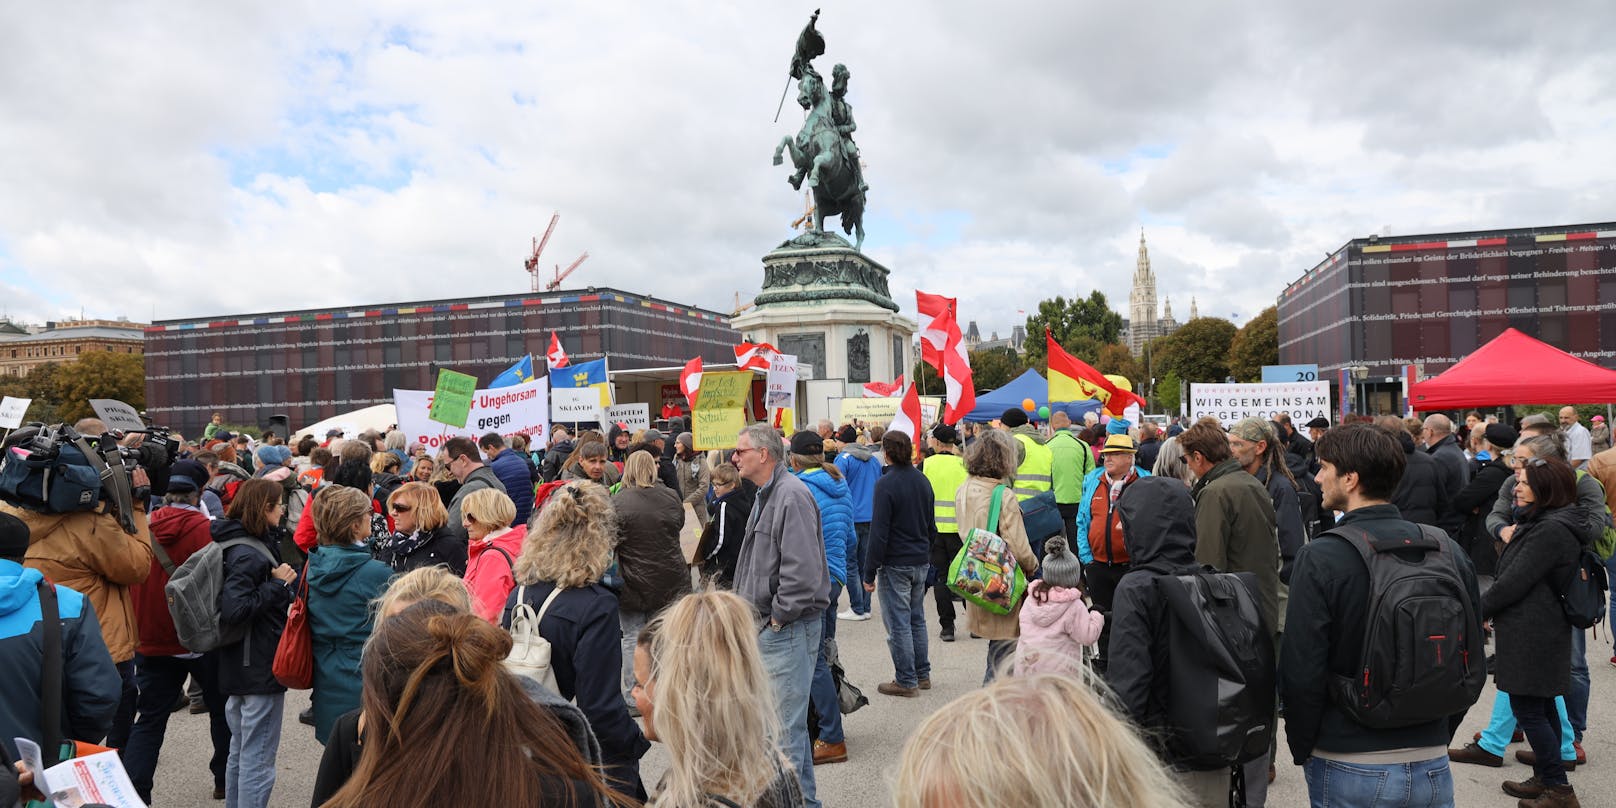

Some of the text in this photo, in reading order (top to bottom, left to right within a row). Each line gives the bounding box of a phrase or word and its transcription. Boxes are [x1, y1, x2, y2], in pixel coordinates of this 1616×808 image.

[1460, 251, 1509, 259] Brüderlichkeit
[1510, 248, 1544, 258] begegnen
[1533, 269, 1579, 279] Behinderung
[1362, 313, 1399, 322] Solidarität,
[1436, 309, 1482, 319] Gerechtigkeit
[1296, 372, 1315, 382] 20
[480, 389, 536, 409] Ungehorsam
[1196, 397, 1326, 407] WIR GEMEINSAM
[478, 414, 511, 430] gegen
[698, 411, 728, 424] Schutz
